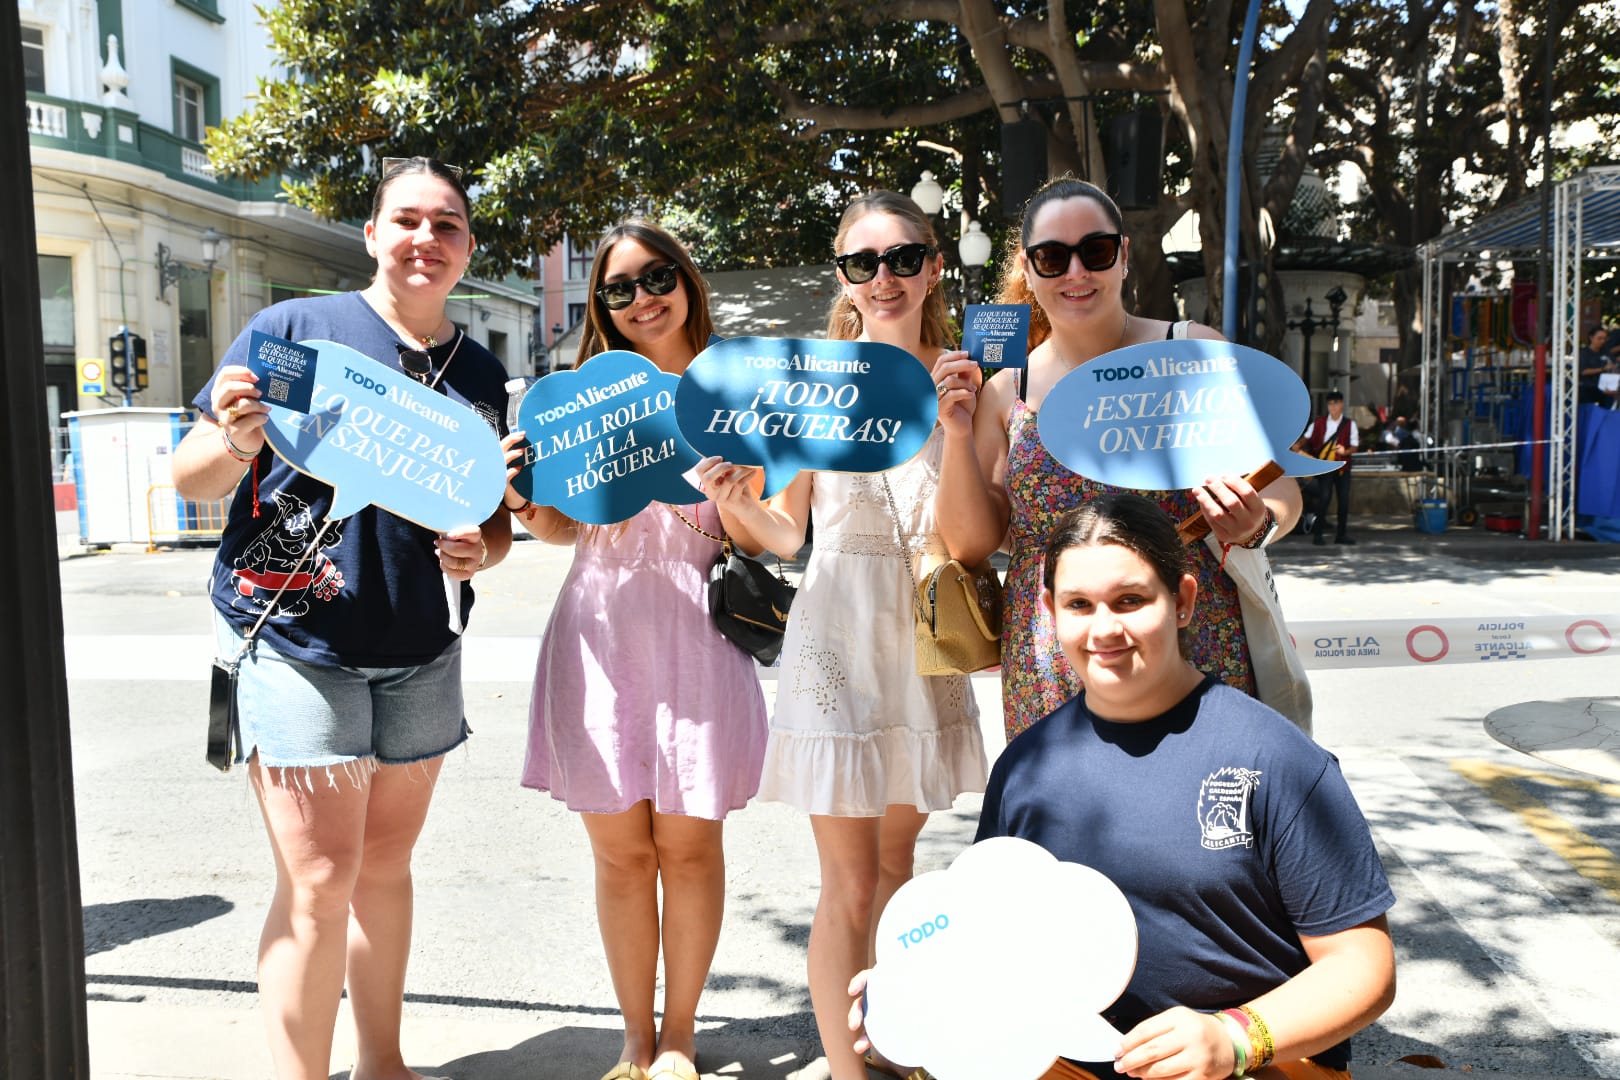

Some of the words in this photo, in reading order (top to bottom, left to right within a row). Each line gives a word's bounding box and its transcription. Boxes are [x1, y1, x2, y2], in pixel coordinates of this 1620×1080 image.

[271, 350, 307, 365] HOGUERAS
[744, 353, 871, 374] TODOAlicante
[1092, 355, 1238, 383] TODOAlicante
[343, 366, 461, 433] TODOAlicante
[534, 371, 649, 426] TODOAlicante
[750, 380, 860, 410] ¡TODO
[1083, 384, 1248, 430] ¡ESTAMOS
[310, 383, 351, 416] LO
[348, 405, 411, 447] QUE
[408, 431, 476, 478] PASA
[523, 440, 551, 467] EL
[550, 420, 600, 455] MAL
[607, 427, 639, 457] LA
[703, 408, 902, 444] HOGUERAS!
[1099, 425, 1149, 454] ON
[282, 412, 338, 439] EN
[329, 425, 392, 468] SAN
[381, 452, 471, 508] JUAN...
[565, 437, 676, 498] HOGUERA!
[1204, 834, 1246, 848] ALICANTE
[896, 913, 949, 949] TODO
